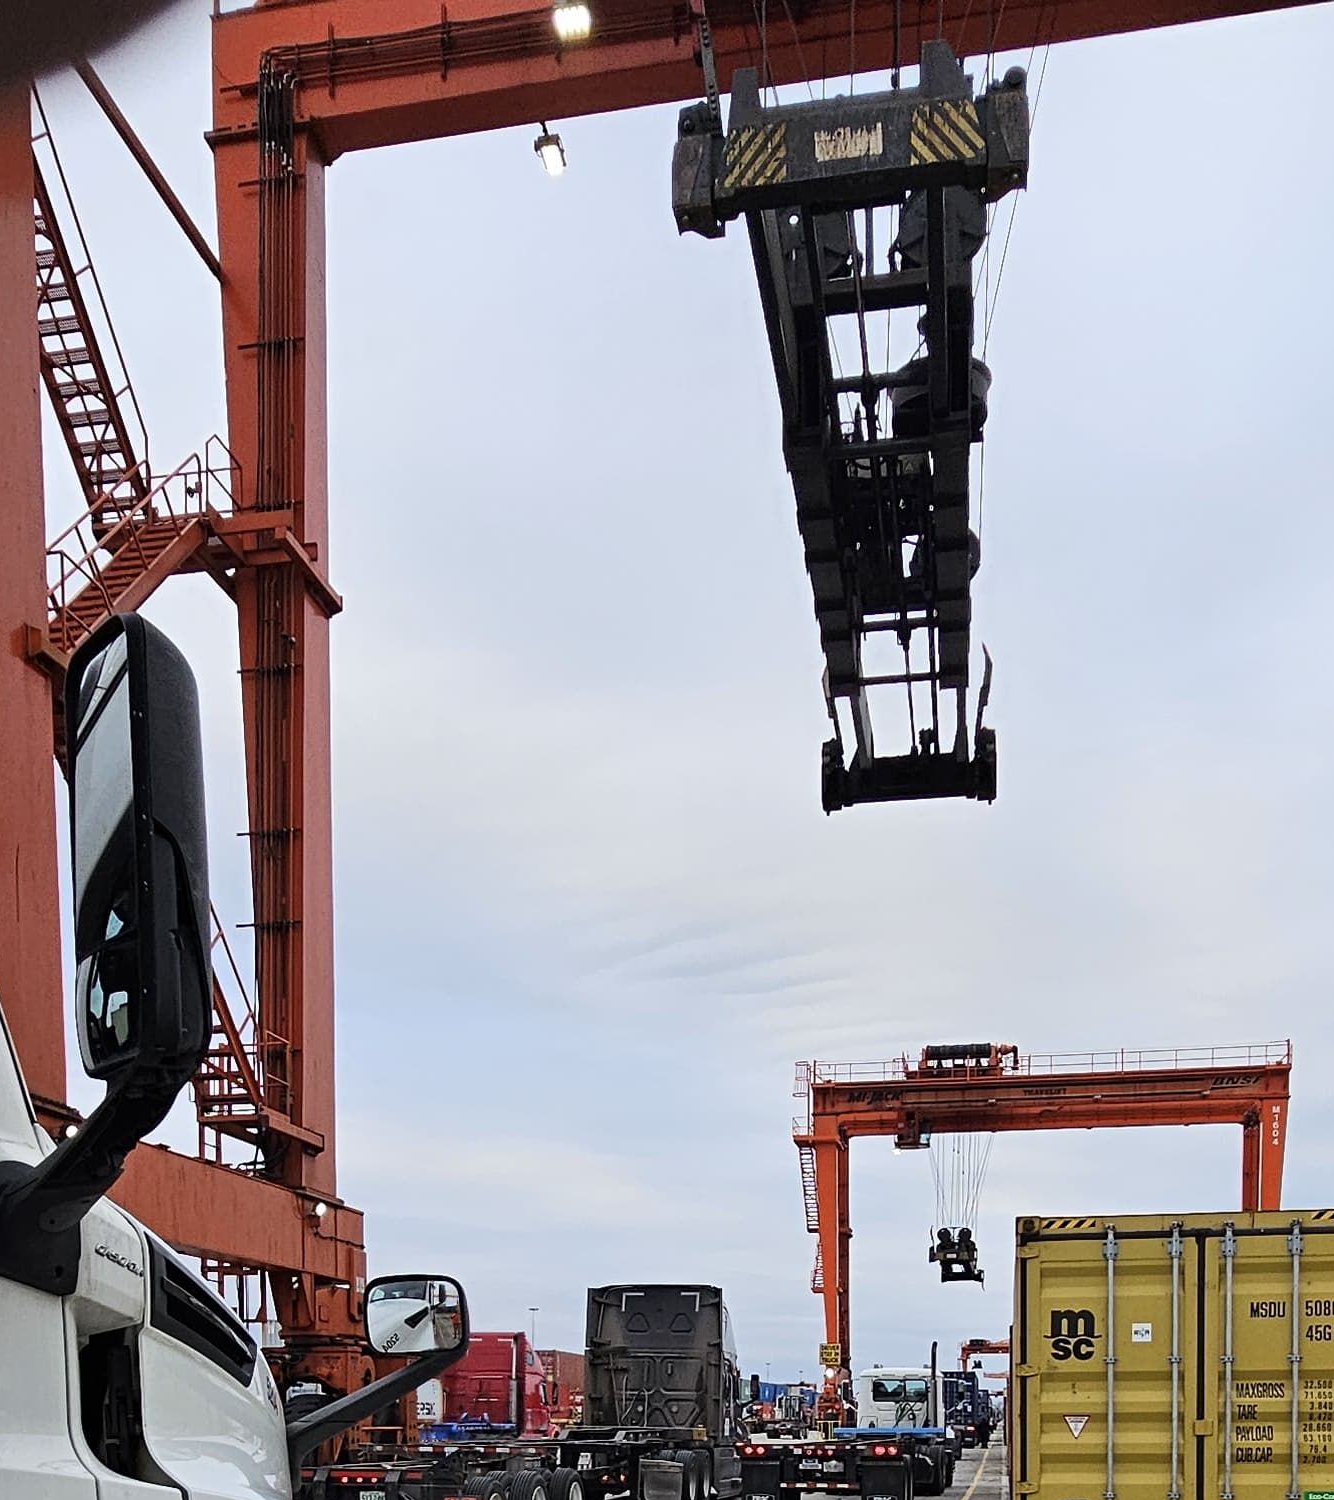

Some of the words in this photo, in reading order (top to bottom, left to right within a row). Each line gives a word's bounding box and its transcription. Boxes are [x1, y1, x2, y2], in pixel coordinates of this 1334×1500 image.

[1250, 1301, 1286, 1318] MSDU
[1236, 1383, 1285, 1398] MAXGROSS
[1236, 1404, 1259, 1420] TARE
[1236, 1425, 1274, 1441] PAYLOAD
